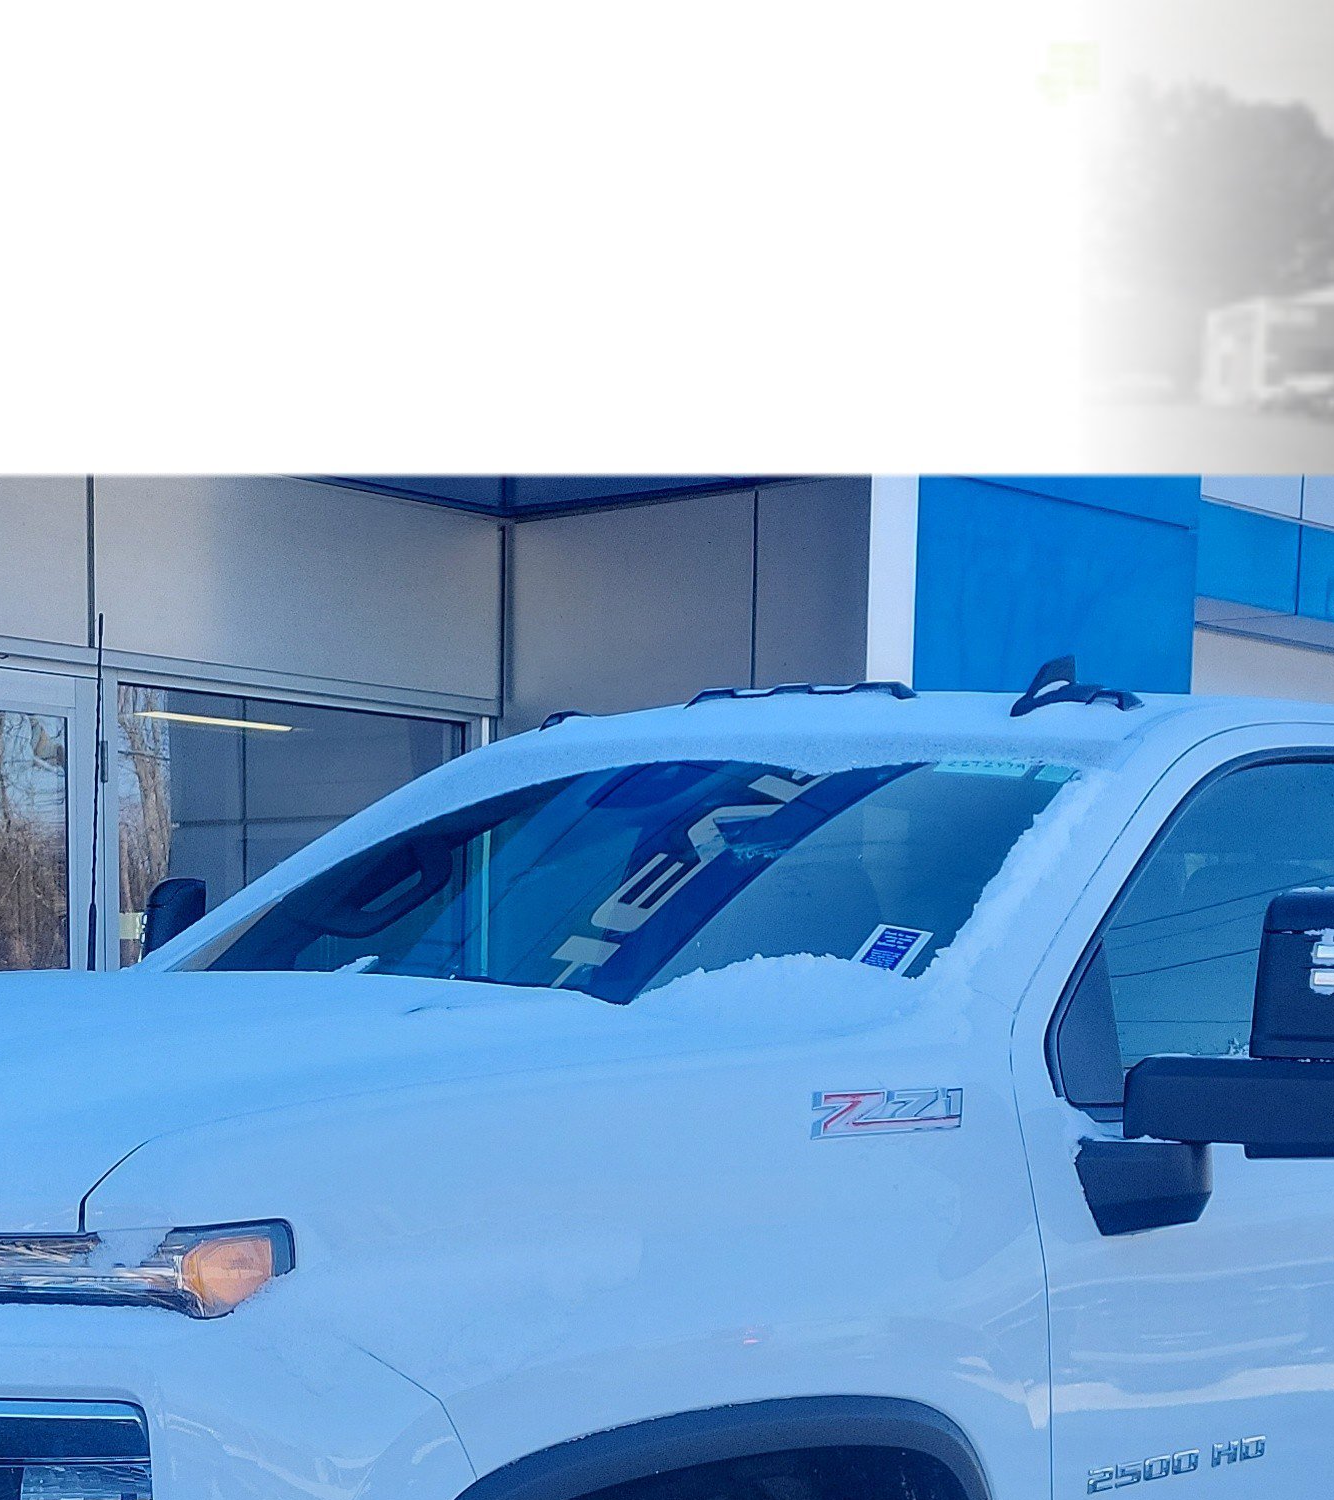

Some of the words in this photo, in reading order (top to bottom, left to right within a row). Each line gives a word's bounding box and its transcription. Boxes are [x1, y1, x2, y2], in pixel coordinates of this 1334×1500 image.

[811, 1087, 964, 1141] Z71
[1086, 1449, 1200, 1495] 2500
[1210, 1434, 1267, 1468] HD
